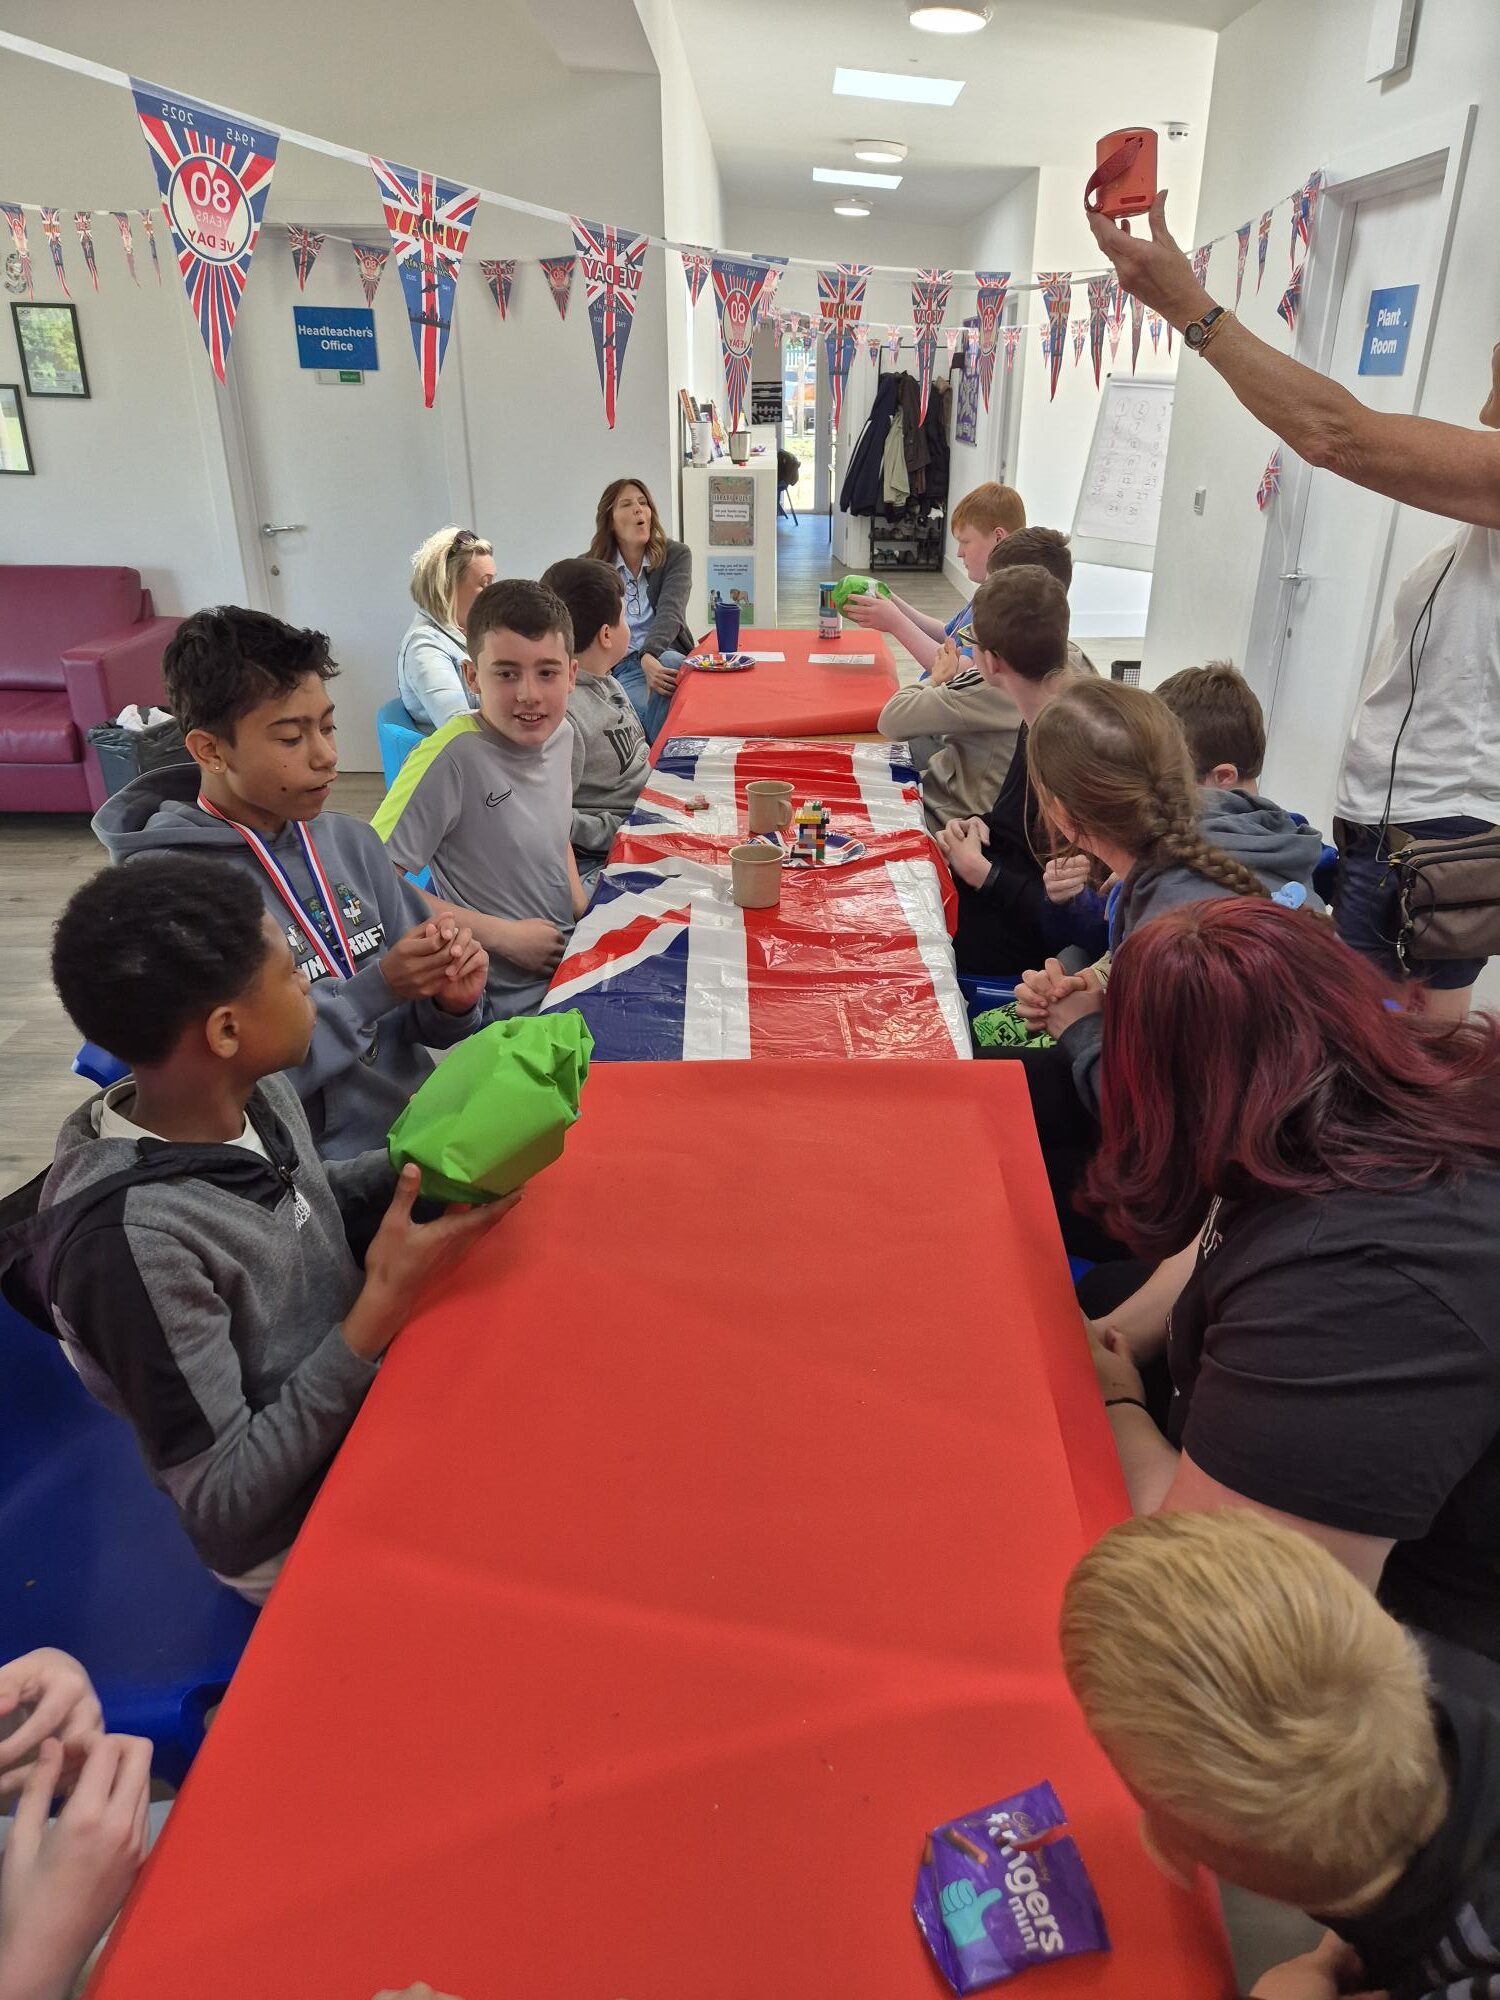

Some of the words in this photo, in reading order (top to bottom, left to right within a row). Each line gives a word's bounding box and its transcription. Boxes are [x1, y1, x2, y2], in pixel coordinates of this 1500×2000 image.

[1377, 308, 1401, 327] Plant
[298, 325, 373, 338] Headteacher's
[321, 340, 354, 351] Office
[1370, 337, 1398, 354] Room
[1008, 1895, 1040, 1951] mini
